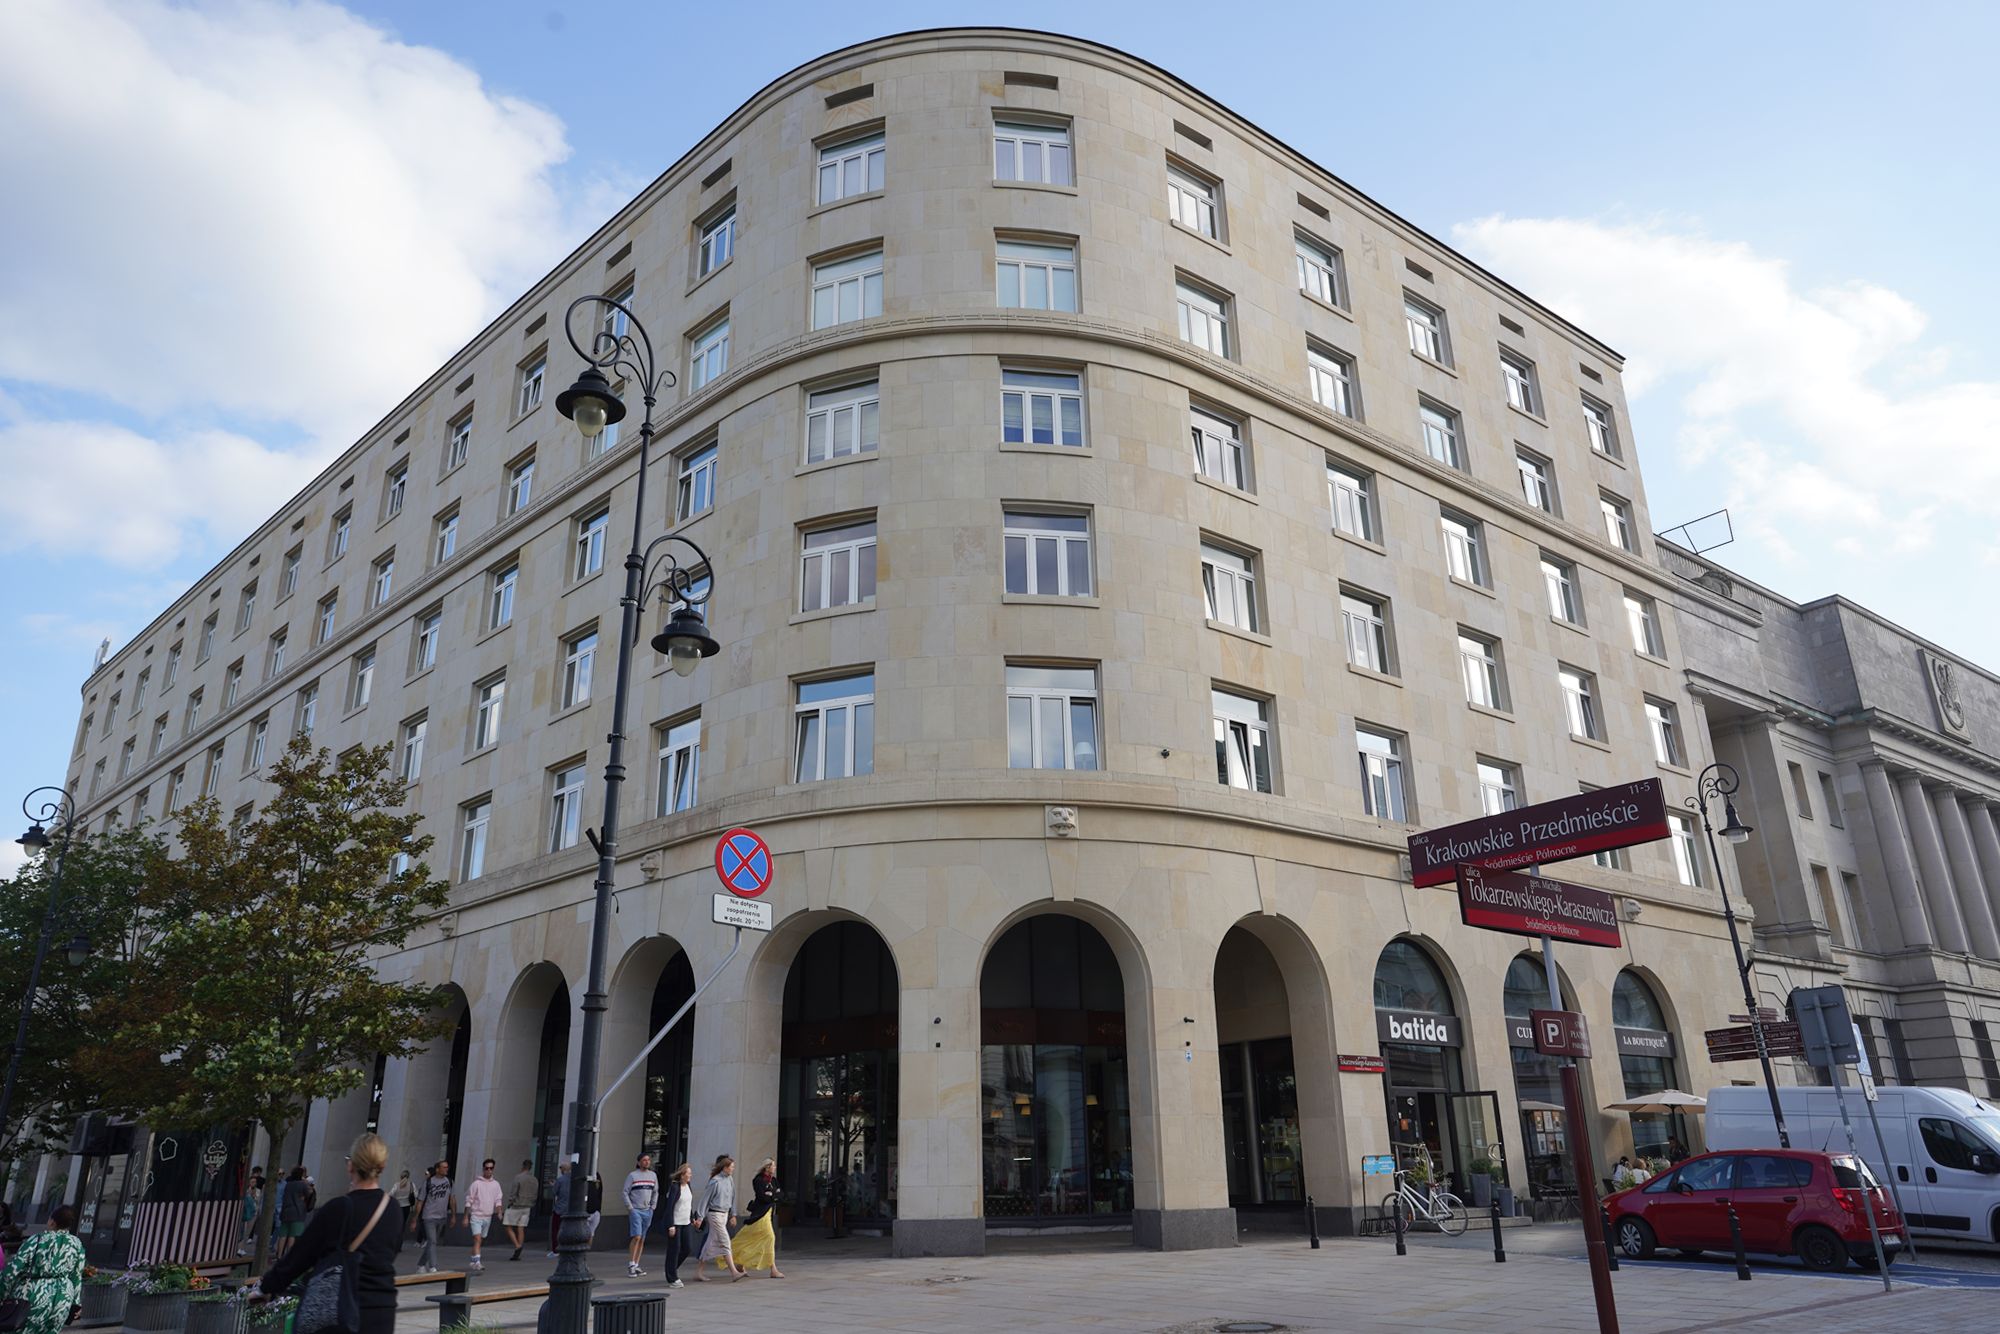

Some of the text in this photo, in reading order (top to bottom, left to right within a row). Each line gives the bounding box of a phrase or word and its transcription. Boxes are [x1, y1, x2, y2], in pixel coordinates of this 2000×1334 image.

[1629, 781, 1651, 795] 11-5
[1412, 834, 1429, 846] ulica
[1425, 799, 1640, 866] Krakowskie Przedmieście
[1536, 844, 1577, 861] Północne
[1465, 865, 1481, 878] ulica
[1466, 877, 1616, 927] Tokarzewskiego-Karaszewicza
[1389, 1015, 1448, 1042] batida
[1546, 1023, 1560, 1043] P
[1623, 1035, 1664, 1049] LA BOUTIQUE
